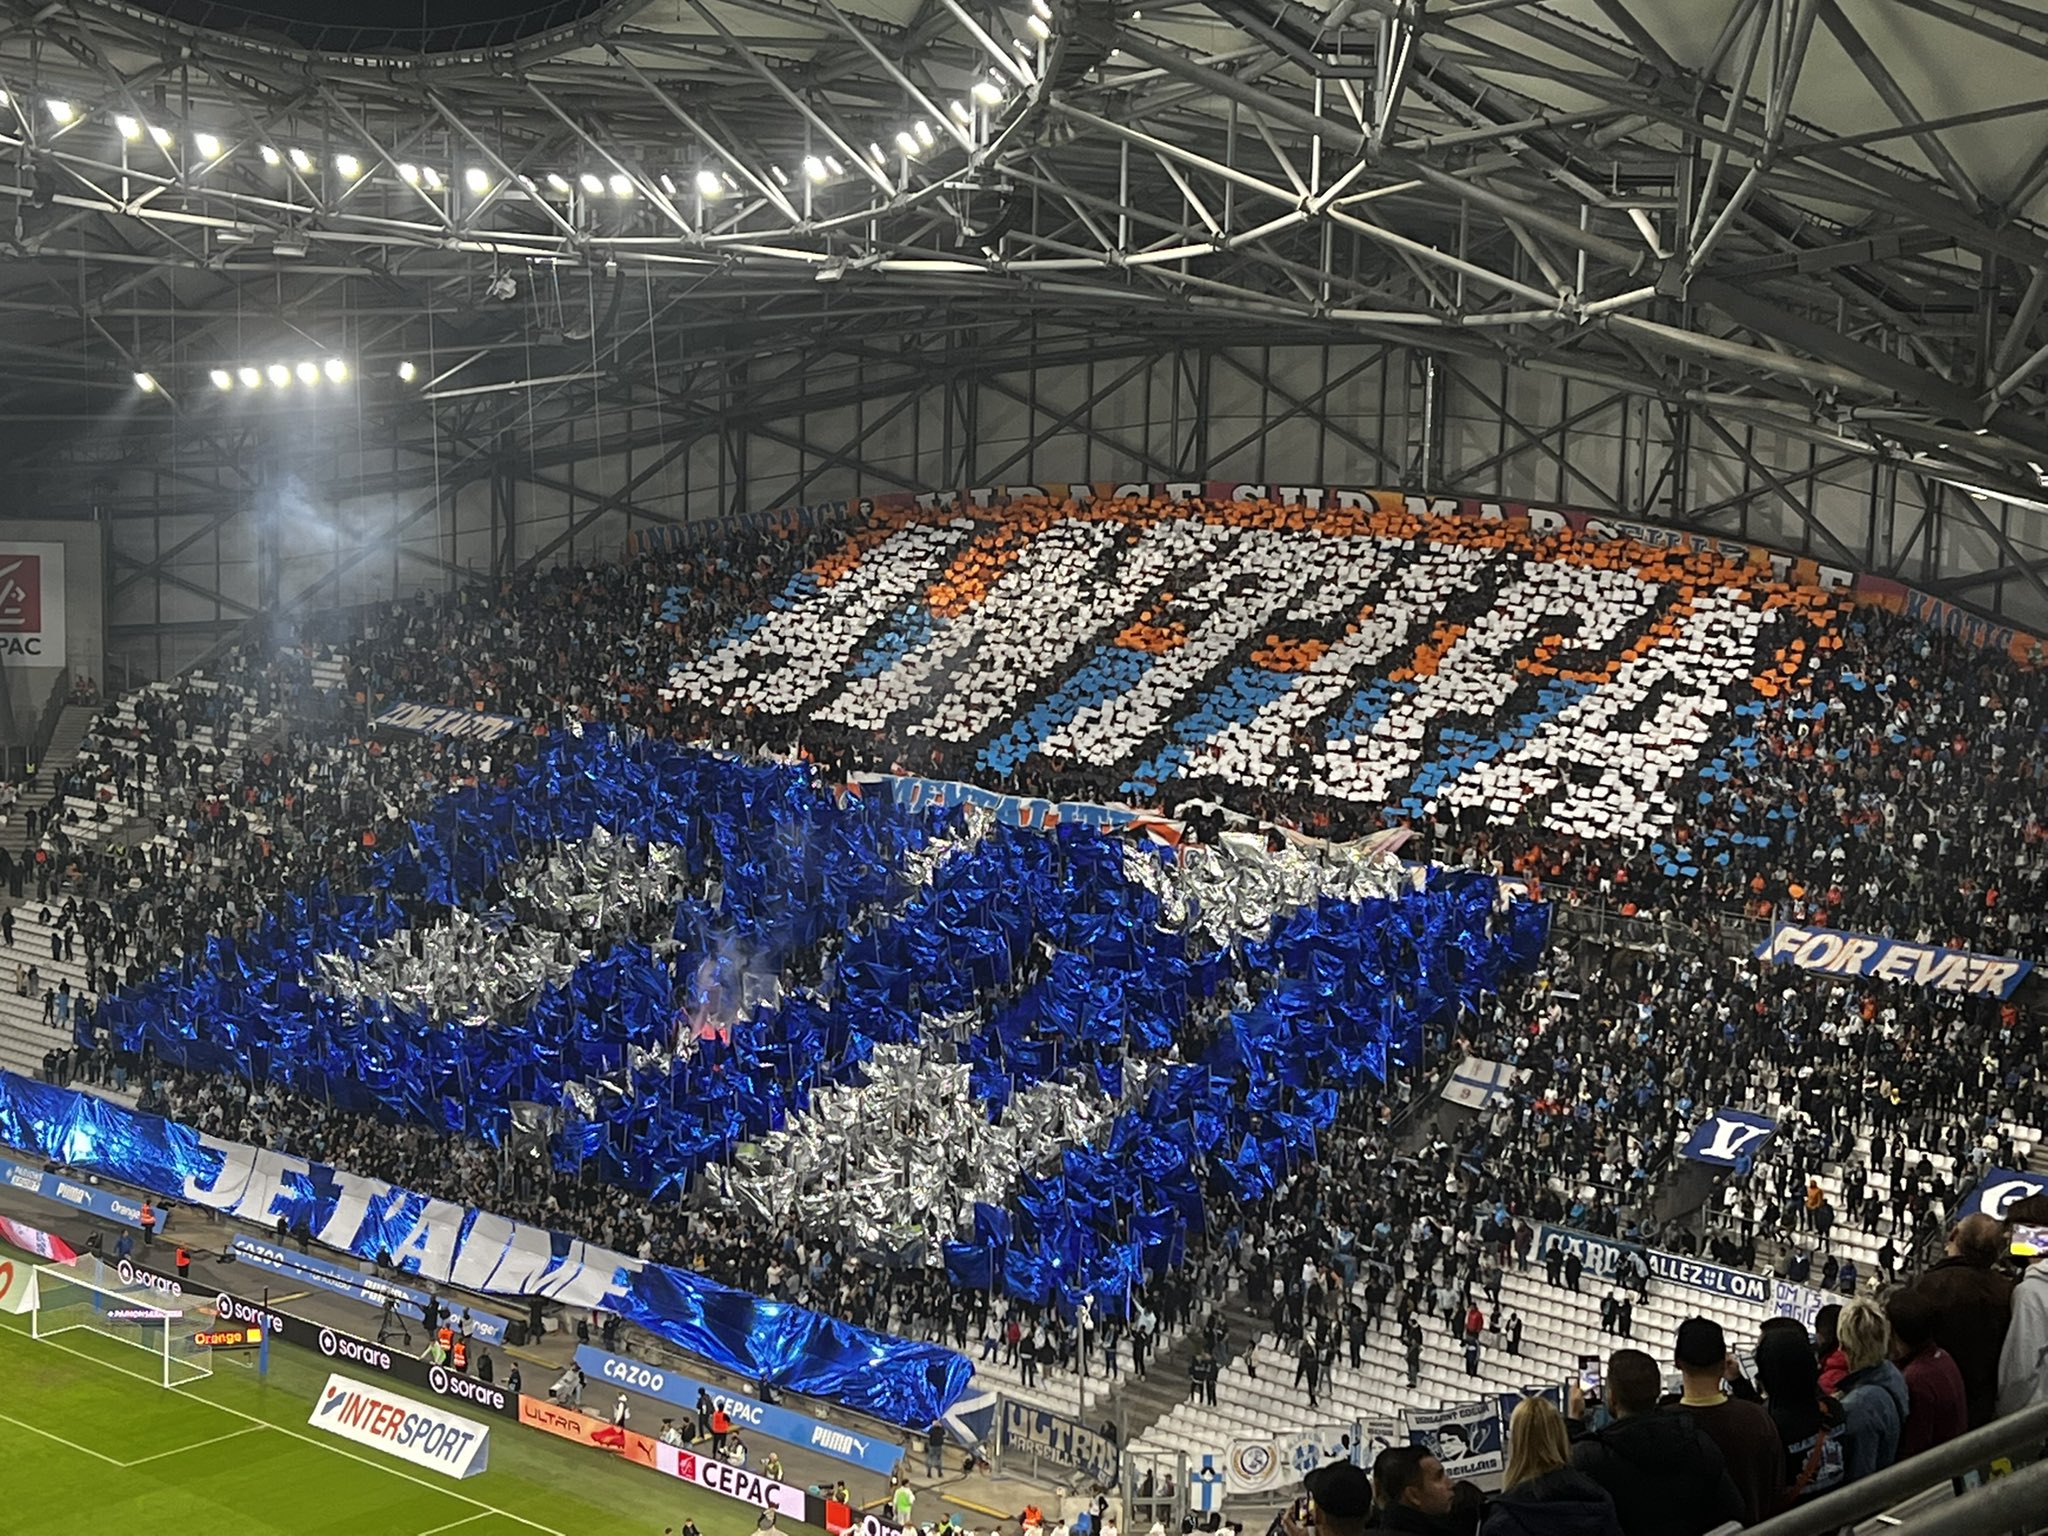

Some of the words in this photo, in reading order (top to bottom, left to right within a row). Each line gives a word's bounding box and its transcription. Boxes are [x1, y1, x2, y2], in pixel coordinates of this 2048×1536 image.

[110, 1200, 141, 1221] Orange
[183, 1133, 312, 1228] JE
[316, 1167, 643, 1310] T'AIME
[235, 1240, 284, 1268] CAZOO
[134, 1268, 182, 1297] sorare
[1648, 1255, 1703, 1285] ALLEZ
[1731, 1276, 1765, 1301] OM
[194, 1333, 243, 1346] Orange
[338, 1336, 391, 1370] sorare
[603, 1358, 664, 1392] CAZOO
[449, 1378, 505, 1410] sorare
[714, 1394, 765, 1426] CEPAC
[342, 1391, 475, 1465] INTERSPORT
[524, 1403, 582, 1435] ULTRA
[811, 1424, 853, 1456] PUMA
[1007, 1402, 1118, 1477] ULTRAS
[702, 1461, 782, 1511] CEPAC
